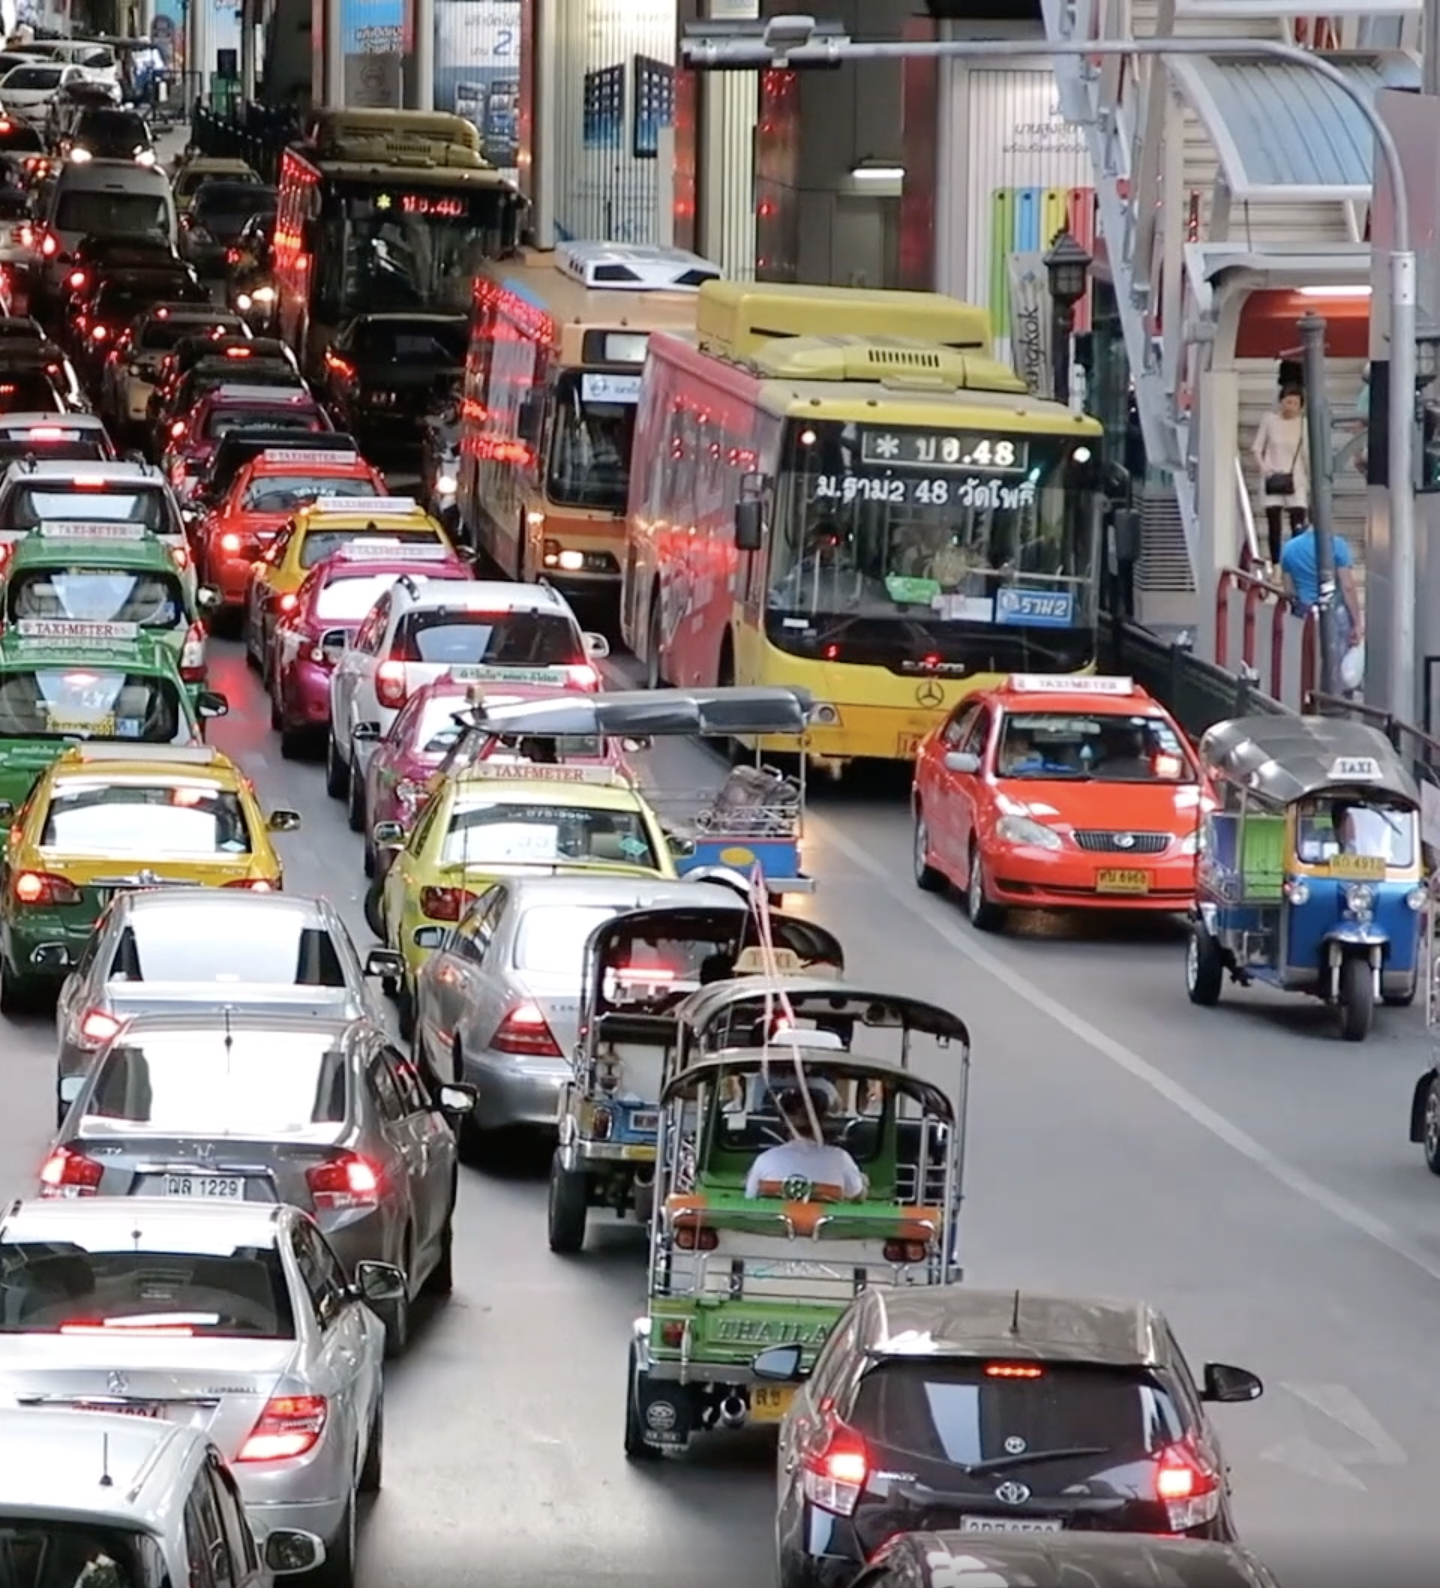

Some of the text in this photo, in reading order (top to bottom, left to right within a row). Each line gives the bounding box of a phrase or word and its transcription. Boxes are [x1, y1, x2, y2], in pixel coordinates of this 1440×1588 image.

[915, 479, 949, 504] 48
[959, 477, 1036, 510] วัดโพธิ
[36, 623, 113, 635] TAXI-METER
[494, 765, 585, 781] TAXI-METER
[1341, 761, 1372, 773] TAXI
[750, 953, 791, 968] TXI
[200, 1179, 238, 1197] 1229
[718, 1317, 829, 1345] THAILA
